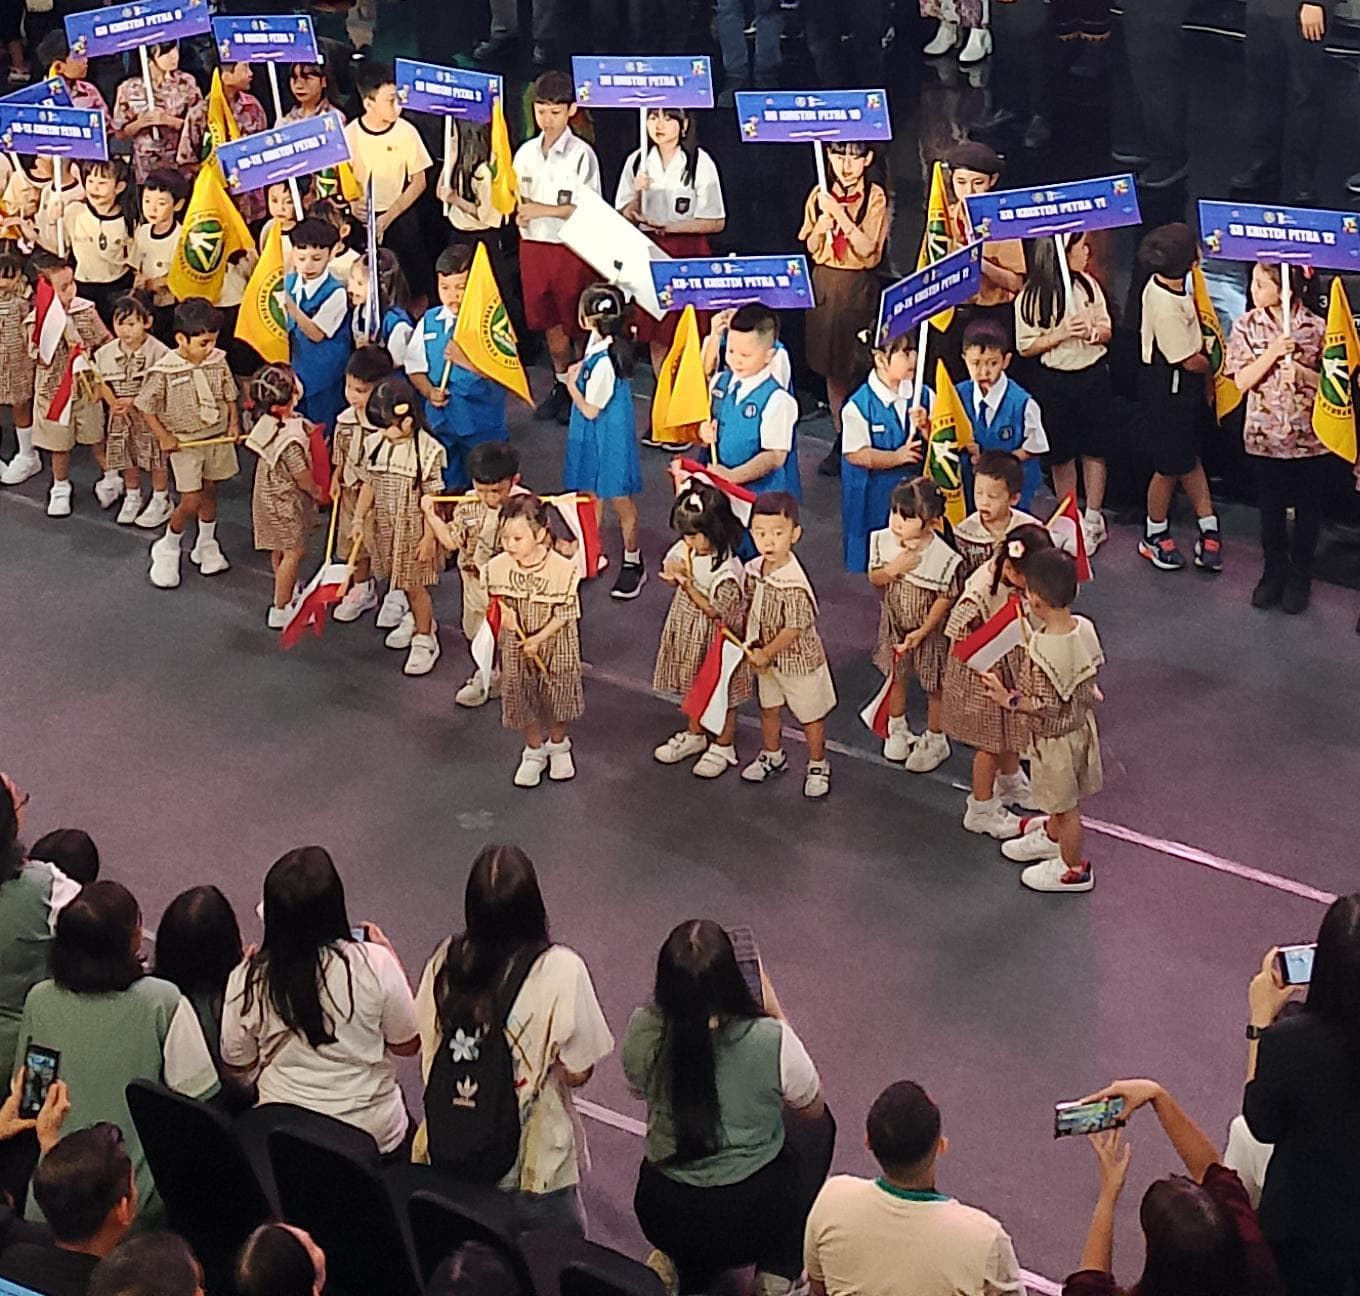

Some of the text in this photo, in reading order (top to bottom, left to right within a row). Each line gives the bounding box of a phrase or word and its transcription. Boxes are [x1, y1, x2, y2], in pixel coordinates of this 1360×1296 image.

[778, 110, 817, 121] KRISTEN
[817, 110, 847, 120] PETRA
[1014, 203, 1059, 219] KRISTEN
[1058, 198, 1092, 213] PETRA
[1245, 225, 1286, 240] KRISTEN
[1287, 228, 1320, 243] PETRA
[743, 275, 775, 288] PETRA
